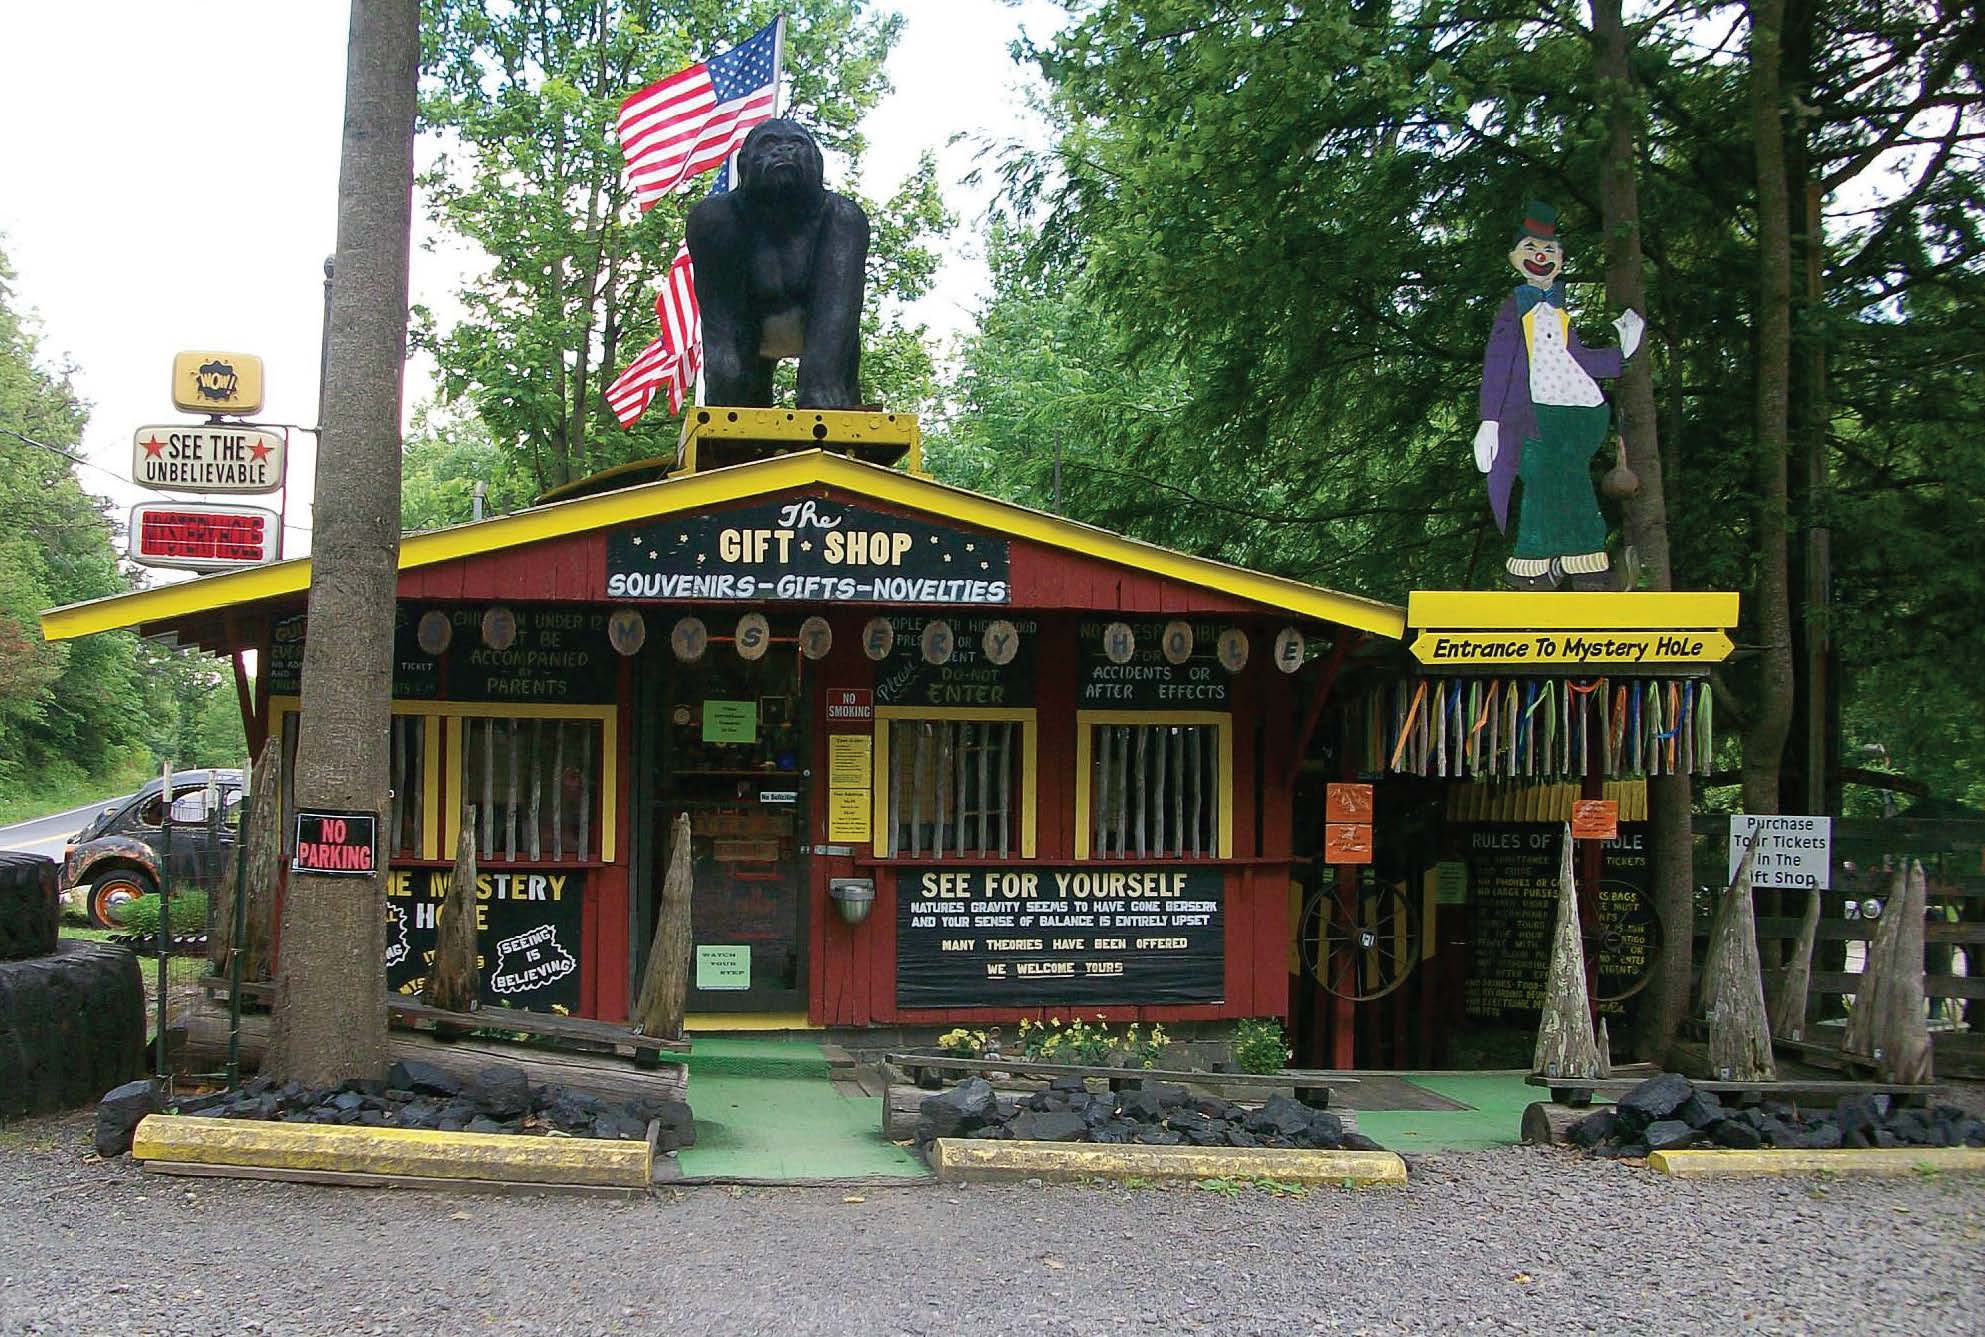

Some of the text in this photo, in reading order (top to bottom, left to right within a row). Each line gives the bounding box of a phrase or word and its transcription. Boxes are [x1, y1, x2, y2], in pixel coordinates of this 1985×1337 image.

[169, 433, 246, 461] SEE THE
[146, 462, 266, 484] UNBELIEVABLE
[778, 500, 843, 528] The
[719, 529, 912, 566] GIFT SHOP
[535, 611, 583, 630] UNDER
[540, 631, 561, 647] BE
[1433, 638, 1529, 658] Entrance
[1536, 638, 1556, 657] To
[1562, 637, 1648, 662] Mystery
[471, 650, 590, 666] ACCOMPANIED
[1093, 666, 1211, 681] ACCIDENTS OR
[488, 678, 567, 695] PARENTS
[928, 683, 1004, 703] ENTER
[1086, 684, 1225, 700] AFTER EFFECTS
[843, 693, 856, 705] NO
[829, 705, 870, 718] SMOKING
[322, 819, 346, 844] NO
[1747, 817, 1813, 830] Purchase
[1472, 832, 1520, 849] RULES
[1529, 833, 1552, 849] OF
[1773, 836, 1826, 849] Tickets
[300, 842, 370, 869] PARKING
[1776, 854, 1802, 867] The
[431, 872, 566, 900] MSTERY
[922, 873, 1187, 898] SEE FOR YOURSELF
[1750, 871, 1817, 886] ift Shop
[911, 901, 1217, 914] NATURES GRAVITY SEEMS TO HAVE GONE BERSERK
[911, 915, 1210, 928] AND YOUR SENSE OF BALANCE IS ENTIRELY UPSET
[502, 929, 550, 954] SEEING
[942, 937, 1187, 951] MANY THEORIES HAVE BEEN OFFERED
[526, 948, 541, 963] IS
[497, 959, 571, 987] BELIEVING
[987, 962, 1123, 976] WE WELCOME YOURS
